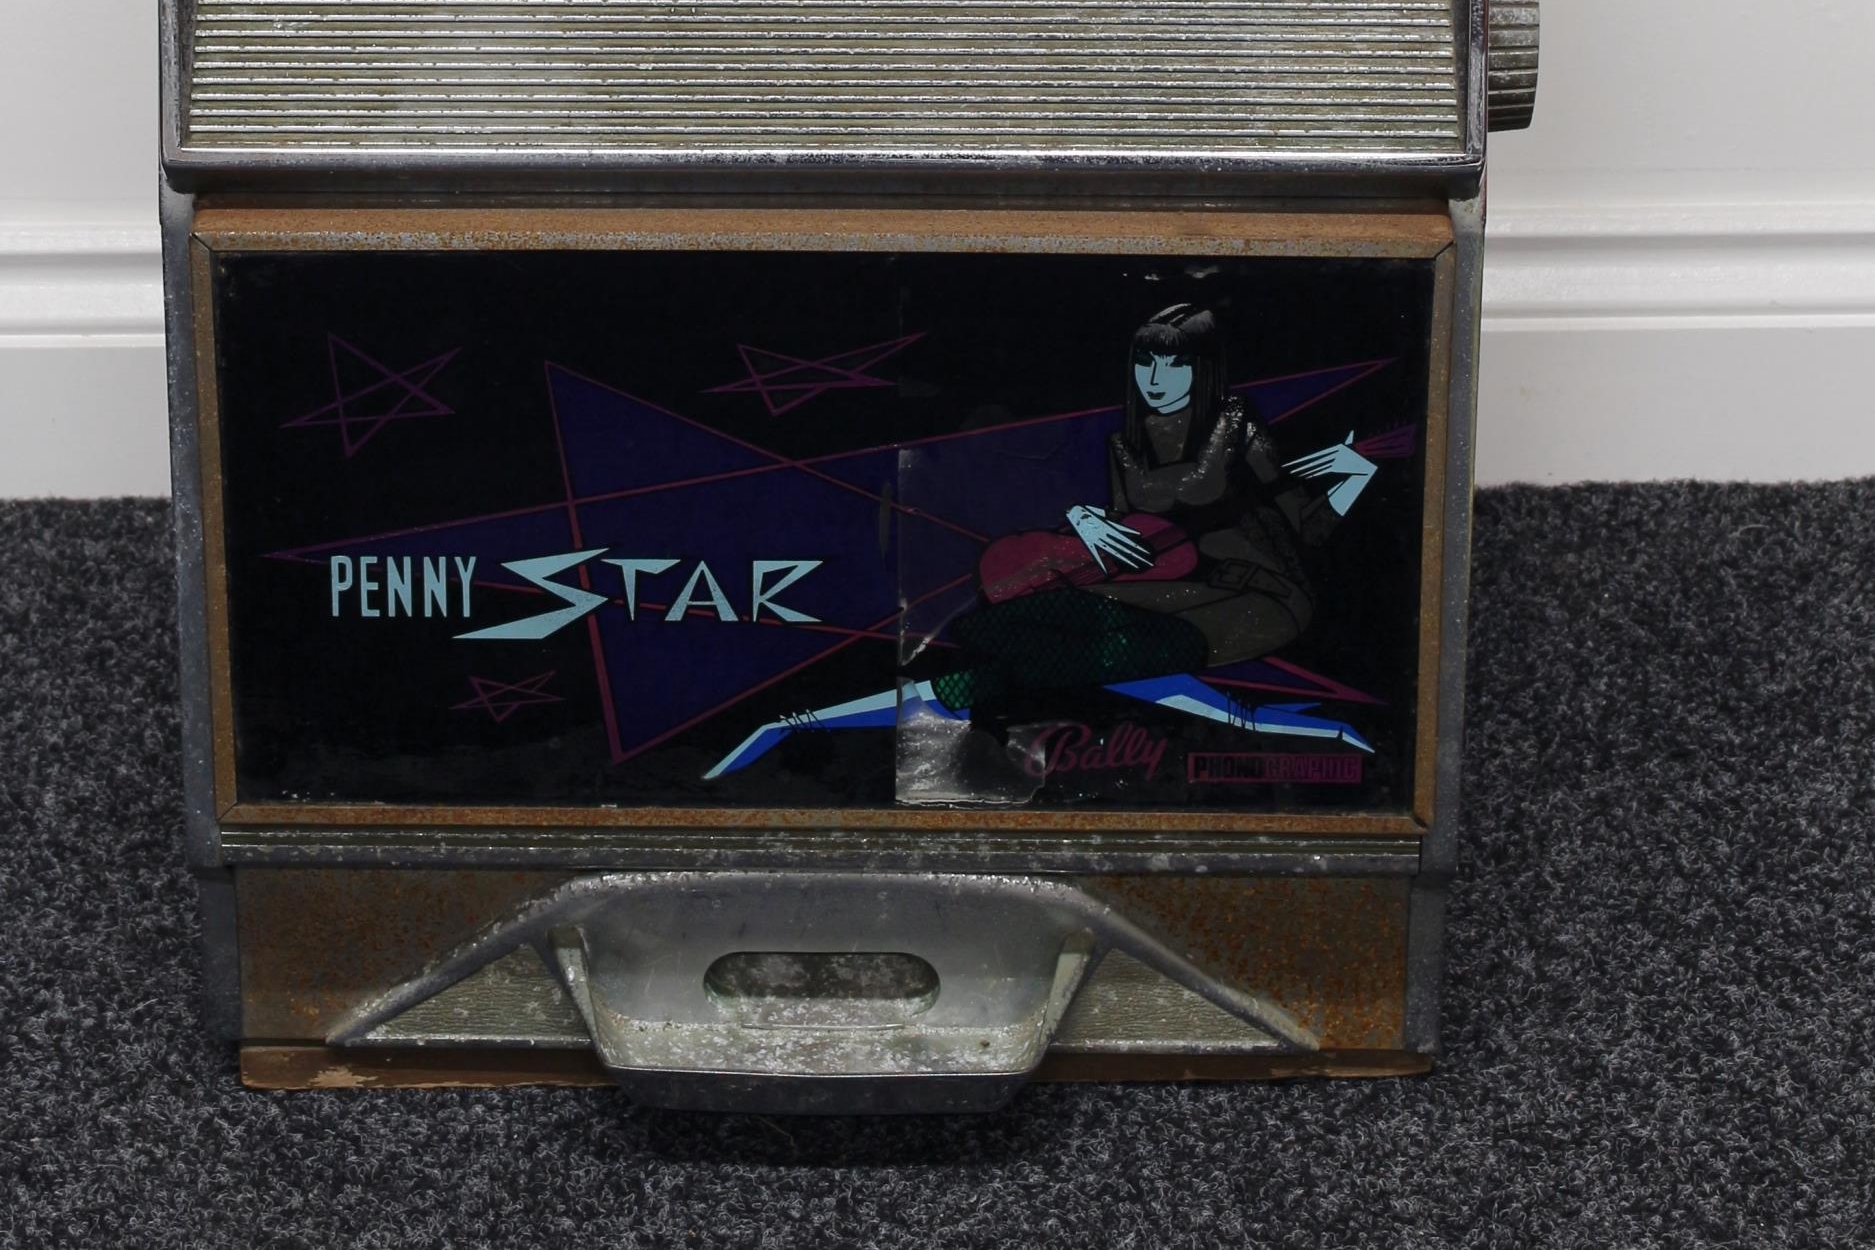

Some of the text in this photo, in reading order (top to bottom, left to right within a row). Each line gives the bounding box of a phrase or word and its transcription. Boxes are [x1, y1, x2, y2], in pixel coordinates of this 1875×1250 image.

[330, 547, 825, 640] PENNY STAR
[1024, 721, 1169, 782] Bally
